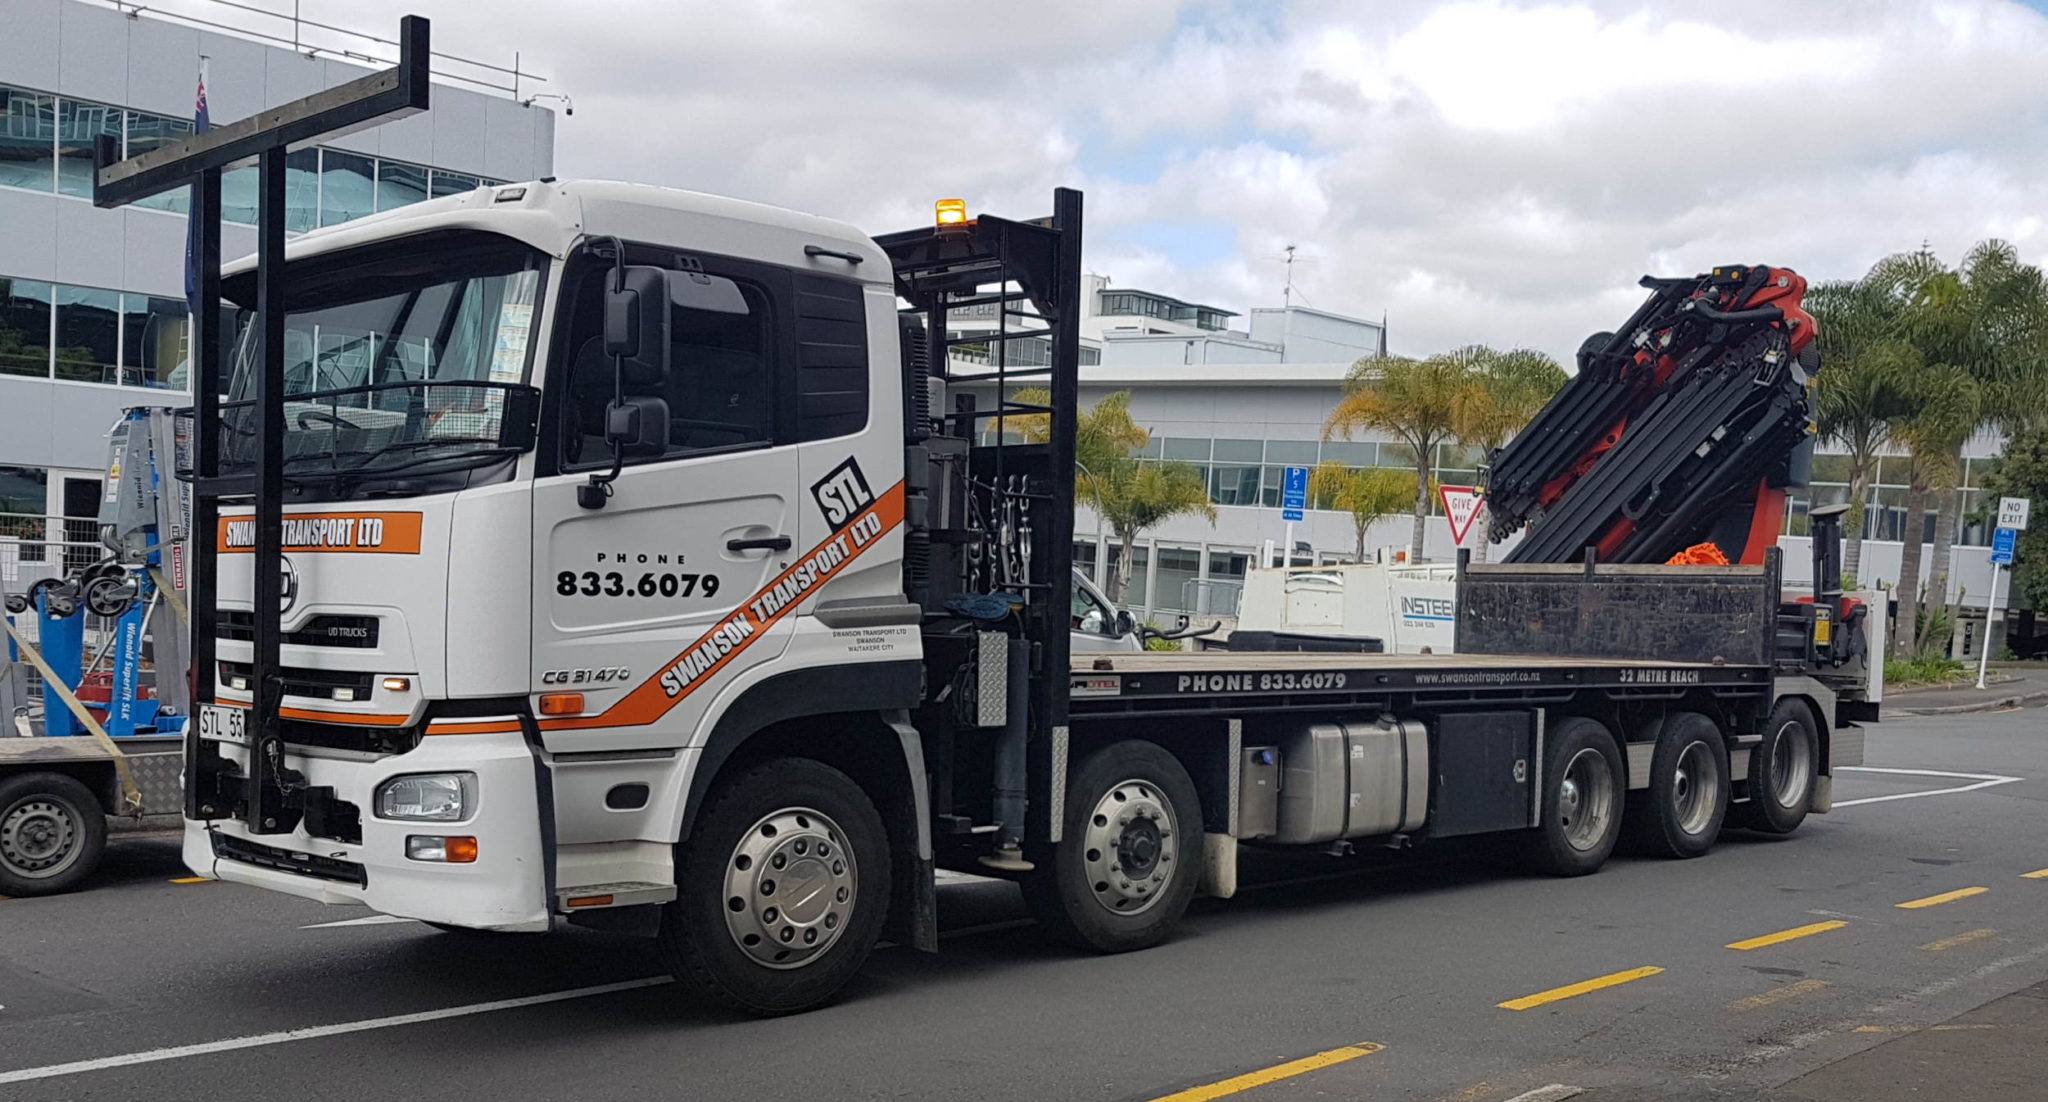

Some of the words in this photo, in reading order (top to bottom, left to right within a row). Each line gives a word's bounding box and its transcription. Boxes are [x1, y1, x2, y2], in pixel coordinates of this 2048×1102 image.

[818, 465, 871, 525] STL
[1452, 497, 1472, 510] GIVE
[2007, 502, 2021, 512] NO
[2001, 513, 2023, 524] EXIT
[226, 521, 256, 547] SWAN
[281, 518, 355, 547] TRANSPORT
[356, 518, 384, 547] LTD
[597, 552, 685, 565] PHONE
[556, 571, 720, 598] 833.6079
[660, 611, 755, 697] SWANSON
[750, 534, 851, 624] TRANSPORT
[849, 511, 882, 548] LTD
[328, 626, 338, 637] UD
[339, 626, 368, 638] TRUCKS
[862, 628, 895, 636] TRANSPORT
[542, 671, 569, 685] CG
[1178, 674, 1253, 692] PHONE
[1260, 672, 1346, 691] 833.6079
[1415, 671, 1541, 686] www.swansontransport.co.nz
[1620, 669, 1634, 683] 32
[1637, 669, 1667, 683] METRE
[1670, 669, 1699, 683] REACH
[202, 710, 222, 736] STL
[230, 713, 243, 738] 55
